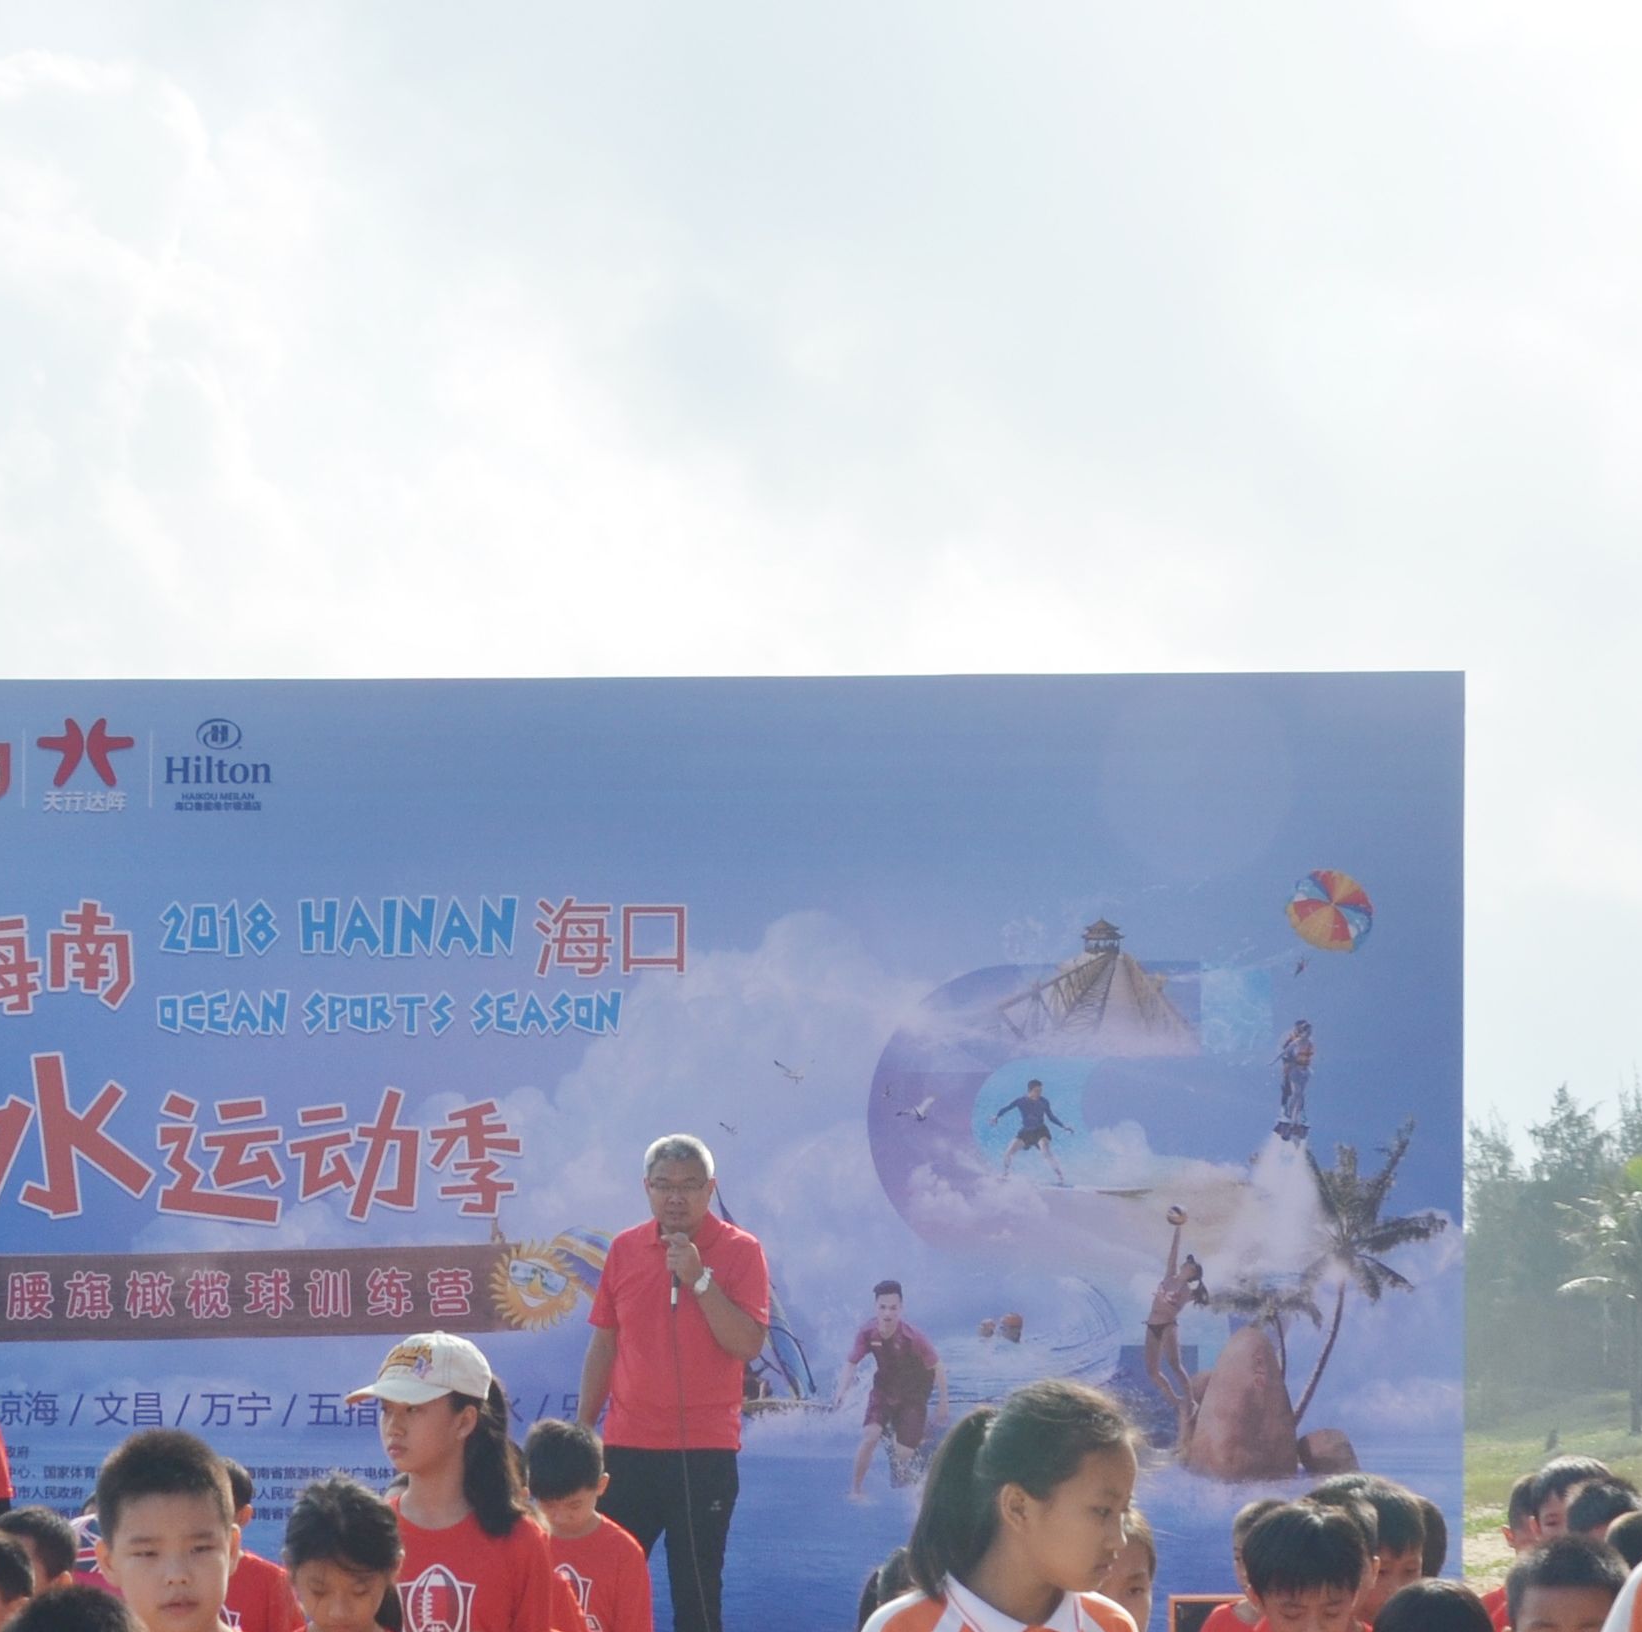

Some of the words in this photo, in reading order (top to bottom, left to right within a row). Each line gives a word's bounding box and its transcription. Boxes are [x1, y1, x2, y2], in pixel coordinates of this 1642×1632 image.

[165, 755, 271, 784] Hilton
[43, 791, 127, 813] 天行达阵
[159, 898, 279, 957] 2018
[299, 896, 519, 958] HAINAN
[535, 896, 688, 978] 海口
[157, 991, 288, 1035] OCEAN
[303, 990, 452, 1036] SPORTS
[471, 990, 622, 1037] SEASON
[95, 1391, 163, 1427] 文昌
[201, 1391, 272, 1427] 万宁
